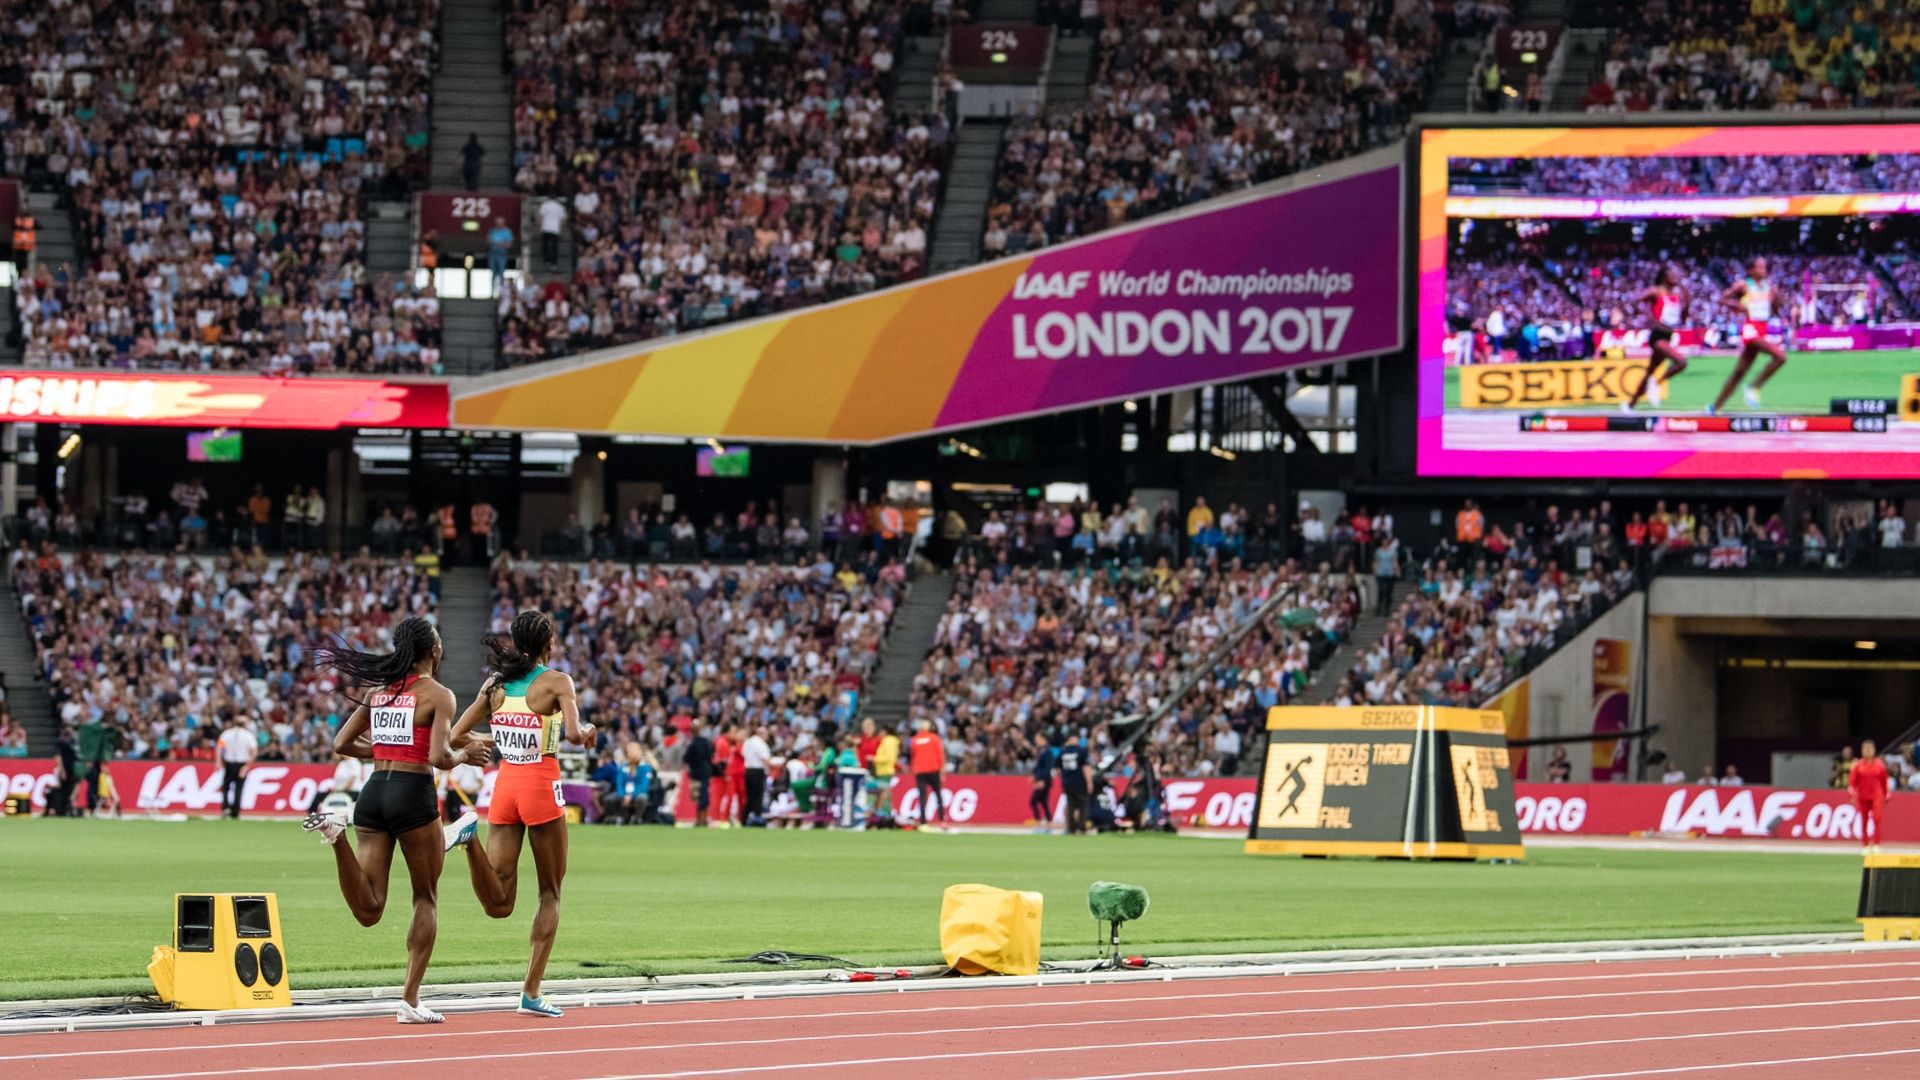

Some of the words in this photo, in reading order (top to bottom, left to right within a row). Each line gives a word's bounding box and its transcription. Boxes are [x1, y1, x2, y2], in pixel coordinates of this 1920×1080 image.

[982, 31, 1018, 49] 224
[1511, 30, 1548, 49] 223
[452, 197, 491, 217] 225
[1013, 270, 1091, 299] IAAF
[1099, 270, 1171, 296] World
[1176, 267, 1353, 300] Championships
[1012, 308, 1231, 359] LONDON
[1238, 306, 1354, 354] 2017
[1478, 365, 1652, 405] SEIKO
[374, 711, 407, 729] OBIRI
[493, 714, 540, 727] TOYOTA
[1360, 710, 1416, 726] SEIKO
[392, 734, 411, 743] 2017
[495, 730, 538, 749] AYANA
[520, 753, 539, 762] 2017
